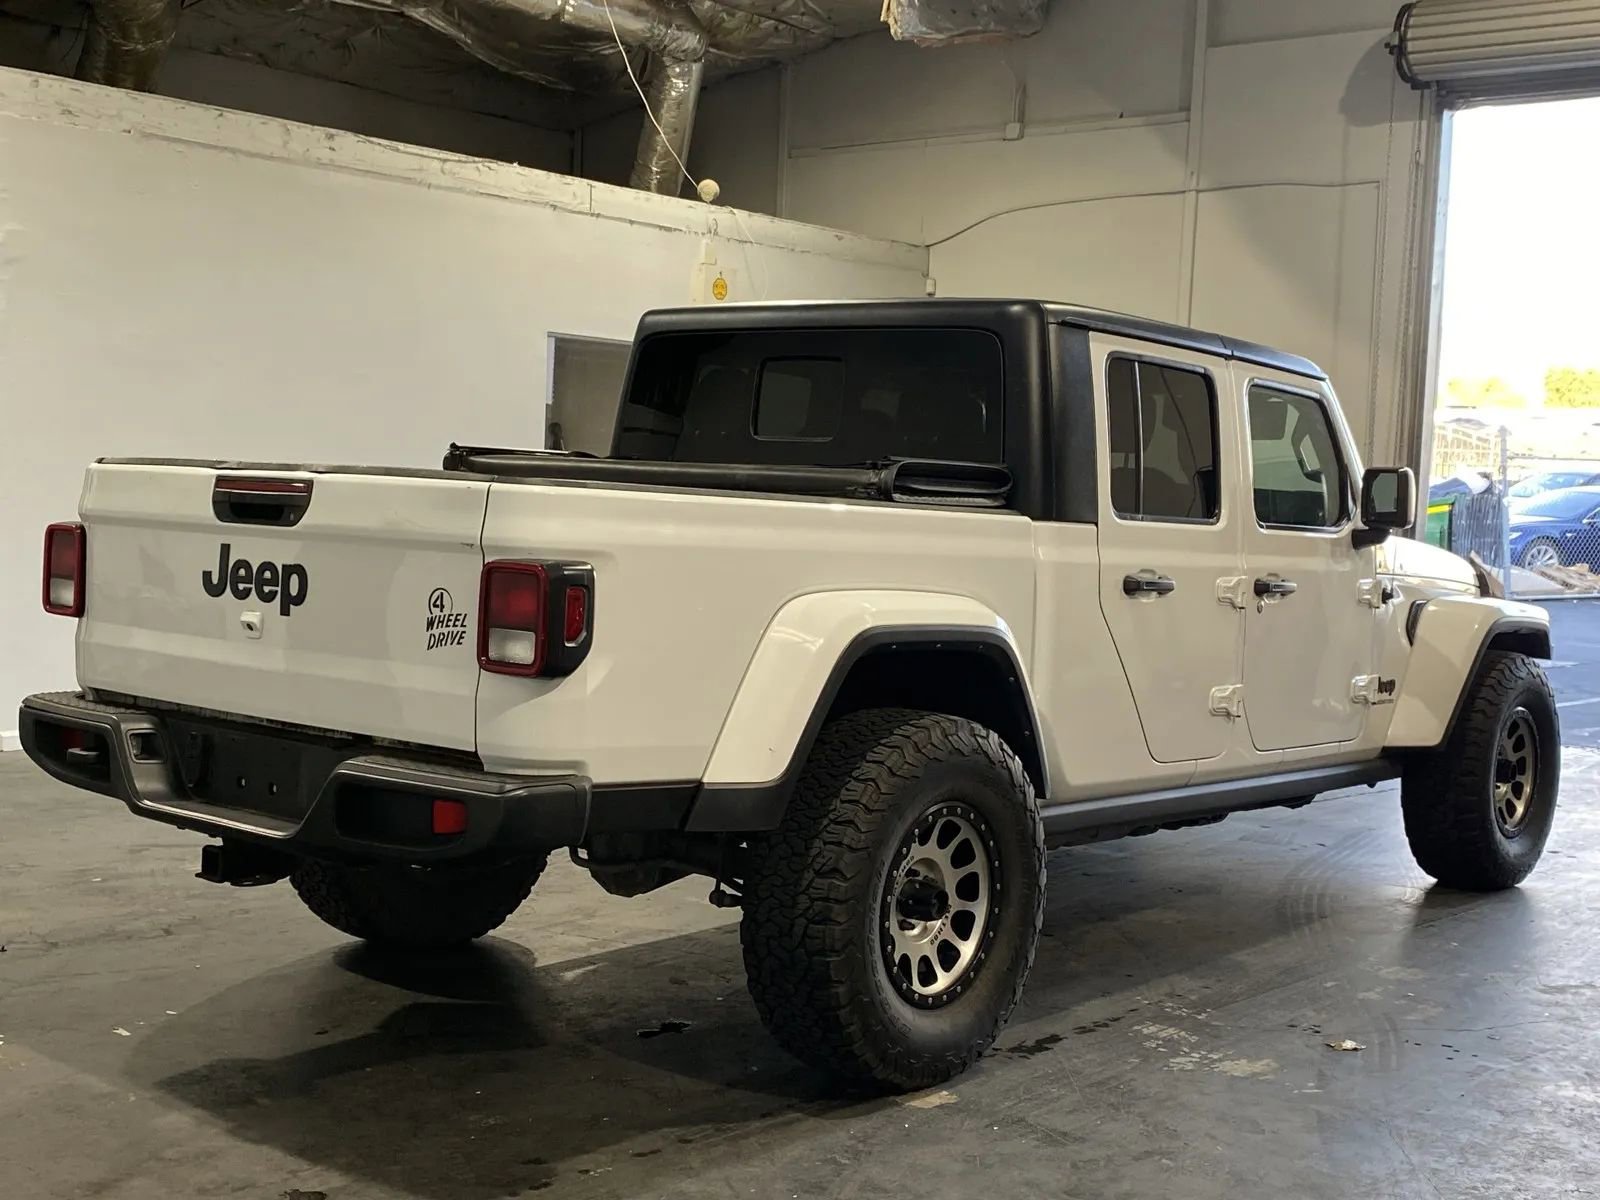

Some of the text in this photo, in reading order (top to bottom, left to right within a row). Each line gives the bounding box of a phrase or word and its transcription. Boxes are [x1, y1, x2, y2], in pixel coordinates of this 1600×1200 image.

[202, 543, 308, 616] Jeep
[432, 592, 445, 612] 4
[426, 613, 467, 632] WHEEL
[427, 630, 467, 650] DRIVE
